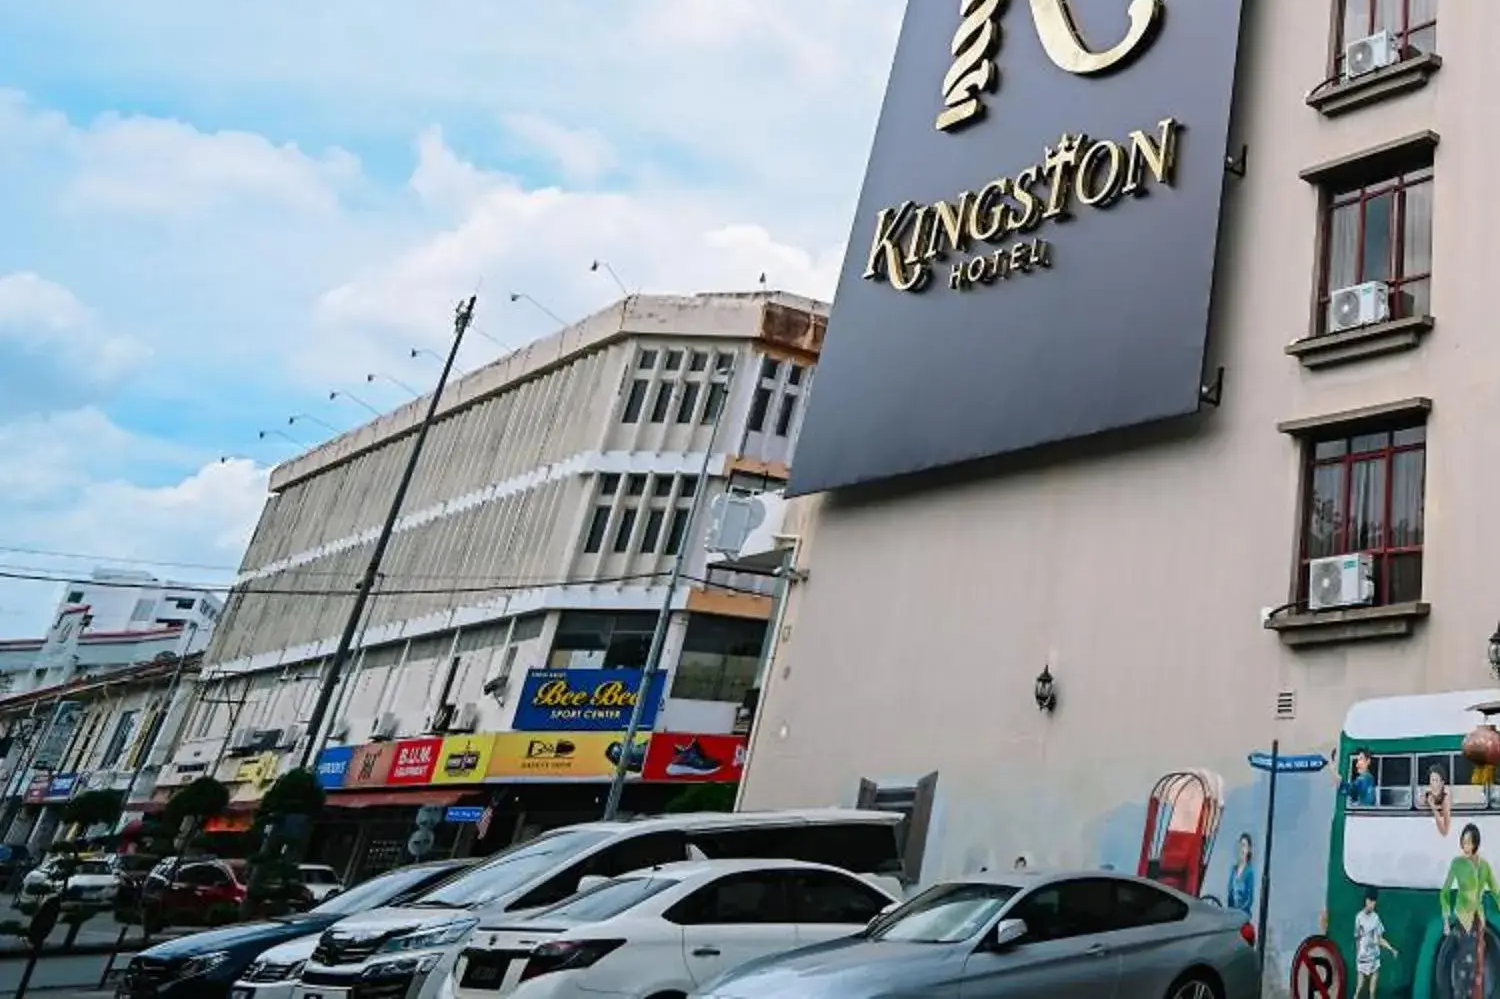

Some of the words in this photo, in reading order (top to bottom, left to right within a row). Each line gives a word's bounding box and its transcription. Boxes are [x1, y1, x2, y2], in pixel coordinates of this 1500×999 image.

[862, 117, 1178, 291] KINGSTON
[949, 238, 1052, 289] HOTEL
[532, 680, 588, 707] Bee
[550, 710, 582, 720] SPORT
[583, 710, 622, 720] CENTER
